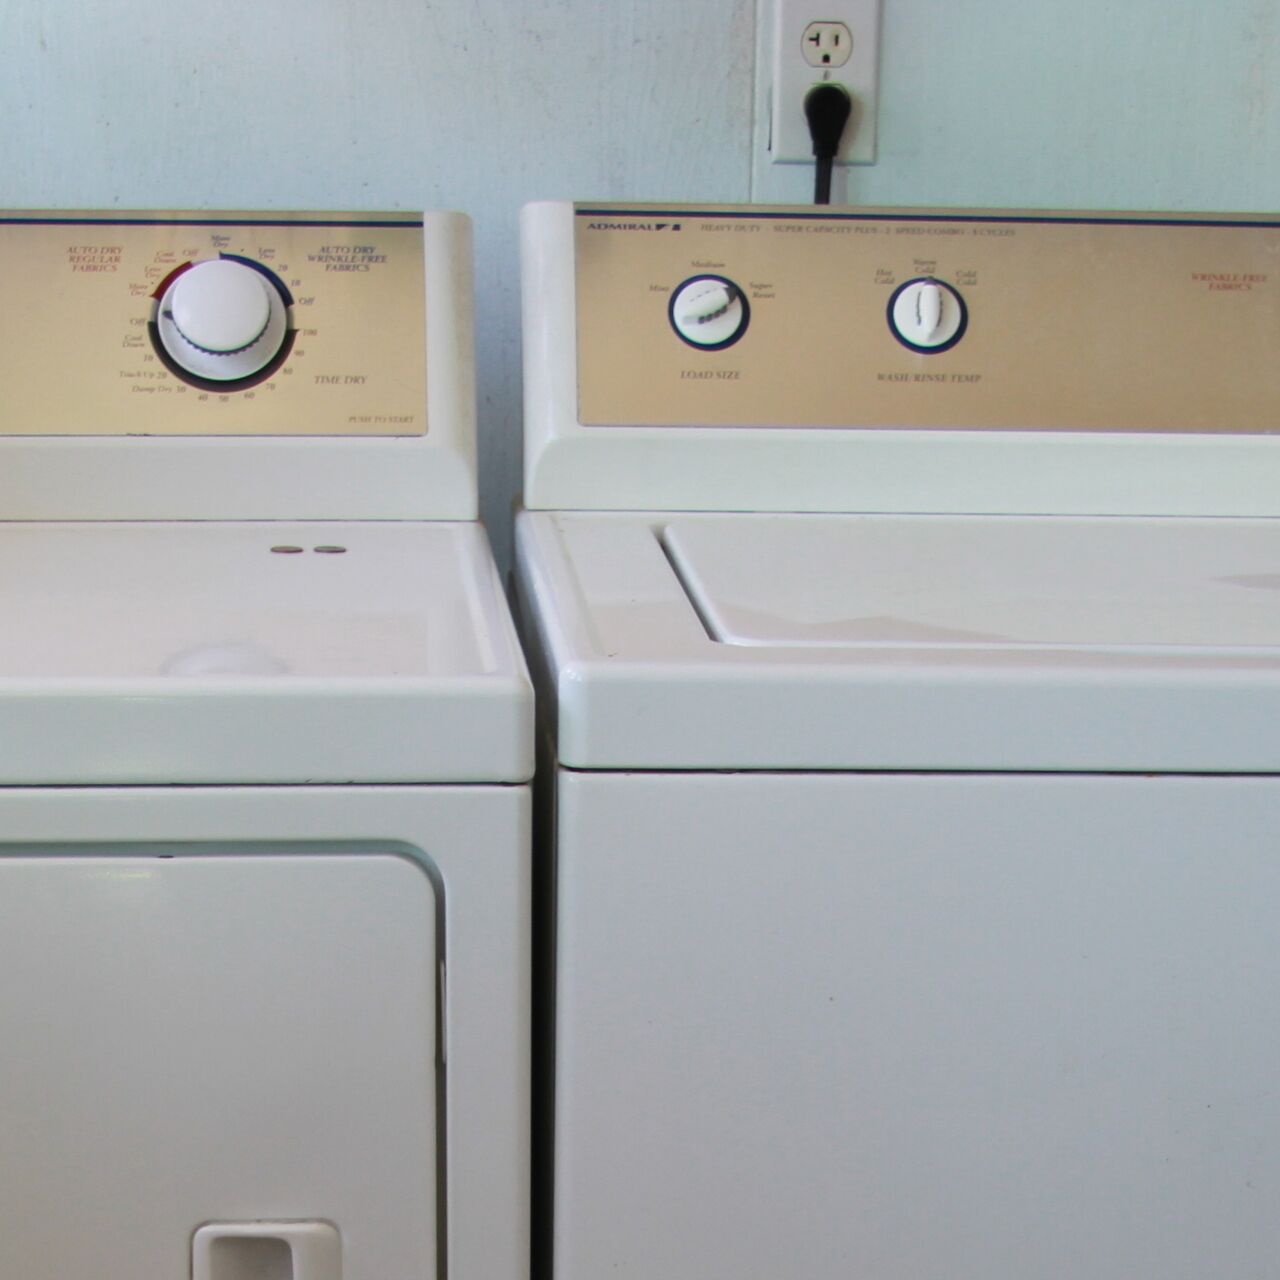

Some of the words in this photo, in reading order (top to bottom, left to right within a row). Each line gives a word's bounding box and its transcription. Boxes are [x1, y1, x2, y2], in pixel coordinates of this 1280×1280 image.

[587, 223, 655, 231] ADMIRAL
[700, 223, 732, 232] HEAVY
[734, 223, 761, 233] DUTY
[773, 224, 804, 233] SUPER
[805, 225, 852, 234] CAPACITY
[66, 246, 98, 255] AUTO
[99, 246, 124, 255] DRY
[319, 246, 351, 254] AUTO
[352, 246, 376, 255] DRY
[69, 255, 122, 264] REGULAR
[307, 254, 388, 264] WRINKLE-FREE
[72, 264, 118, 273] FABRICS
[325, 263, 370, 273] FABRICS
[1191, 273, 1268, 283] WRINKLE-FREE
[1208, 281, 1253, 292] FABRICS
[299, 296, 315, 306] Off
[129, 317, 146, 327] Off
[314, 375, 342, 385] TIME
[343, 375, 368, 385] DRY
[680, 370, 713, 380] LOAD
[715, 370, 741, 380] SIZE
[950, 373, 982, 383] TEMP
[348, 415, 373, 424] PUSH
[374, 415, 387, 424] TO
[388, 415, 415, 424] START
